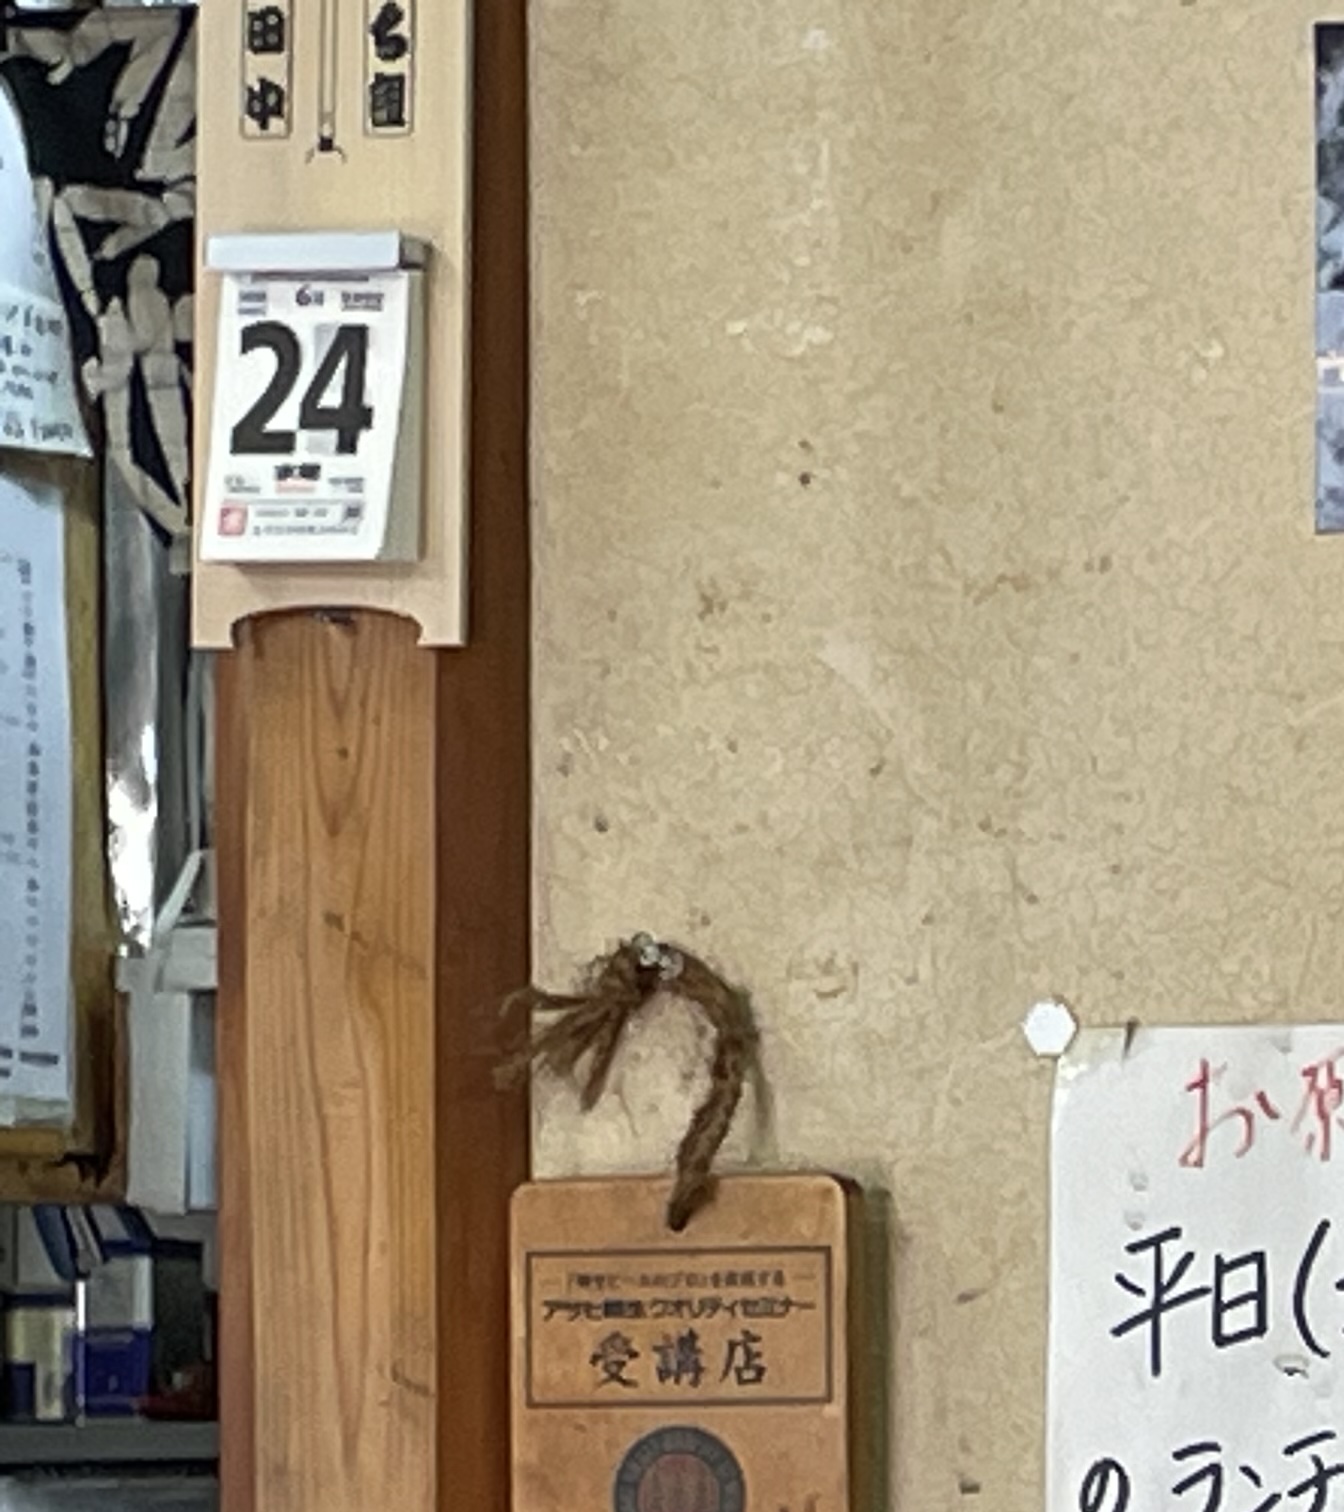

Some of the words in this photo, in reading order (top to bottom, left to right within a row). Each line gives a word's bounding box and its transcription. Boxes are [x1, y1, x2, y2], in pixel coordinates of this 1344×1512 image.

[230, 320, 374, 457] 24
[589, 1327, 768, 1388] 受講店
